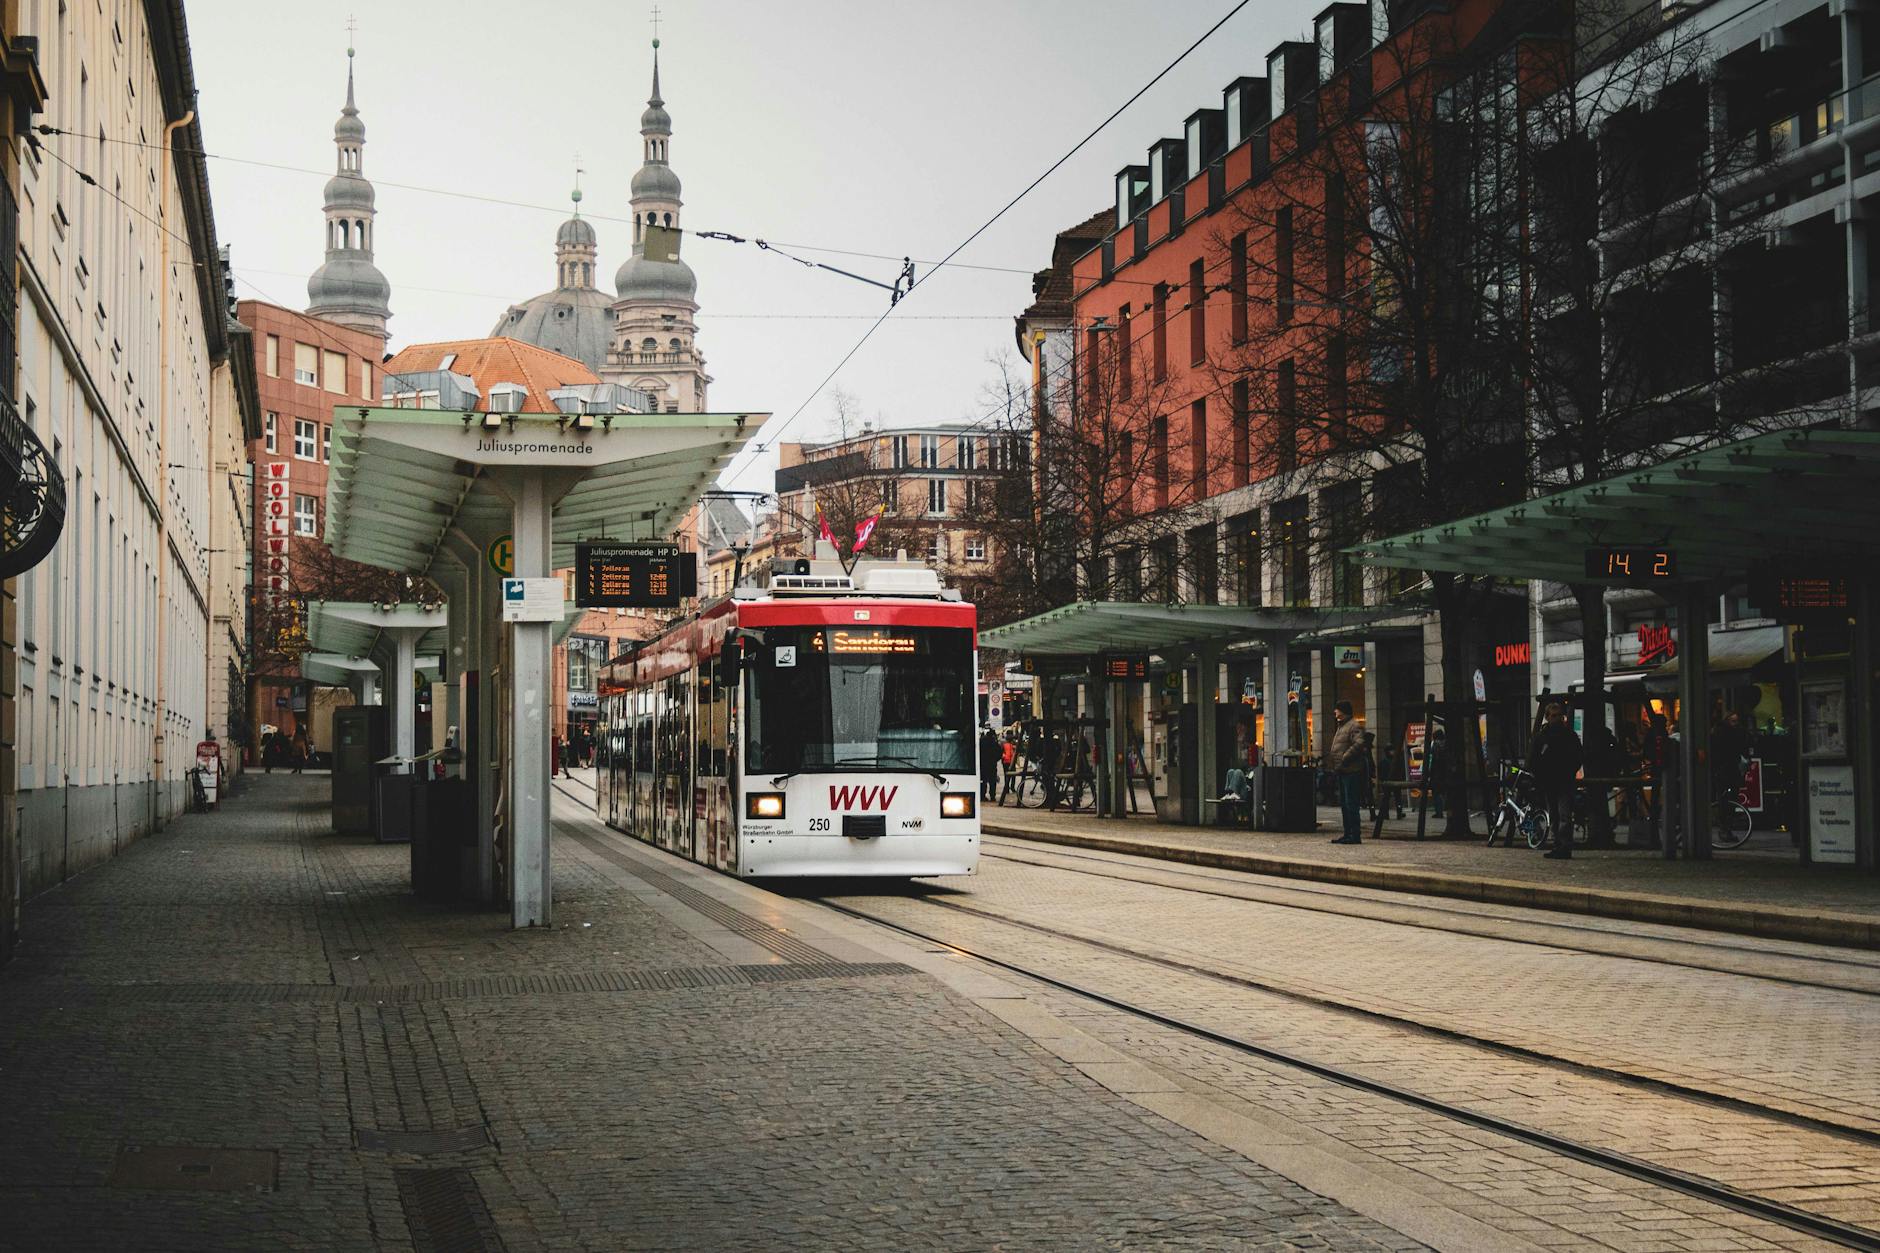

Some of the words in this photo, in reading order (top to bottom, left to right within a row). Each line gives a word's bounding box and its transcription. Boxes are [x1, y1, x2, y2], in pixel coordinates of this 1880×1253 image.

[476, 438, 593, 456] Juliuspromenade
[270, 464, 285, 612] WOOLWORT
[590, 547, 654, 557] Juliuspromenade
[658, 548, 668, 556] HP
[672, 548, 679, 556] D
[812, 631, 824, 651] 4
[834, 631, 915, 652] Sanderau
[1343, 649, 1359, 659] dm
[1024, 658, 1034, 672] B
[829, 785, 899, 811] WVV
[809, 818, 830, 831] 250
[902, 820, 922, 829] NVM
